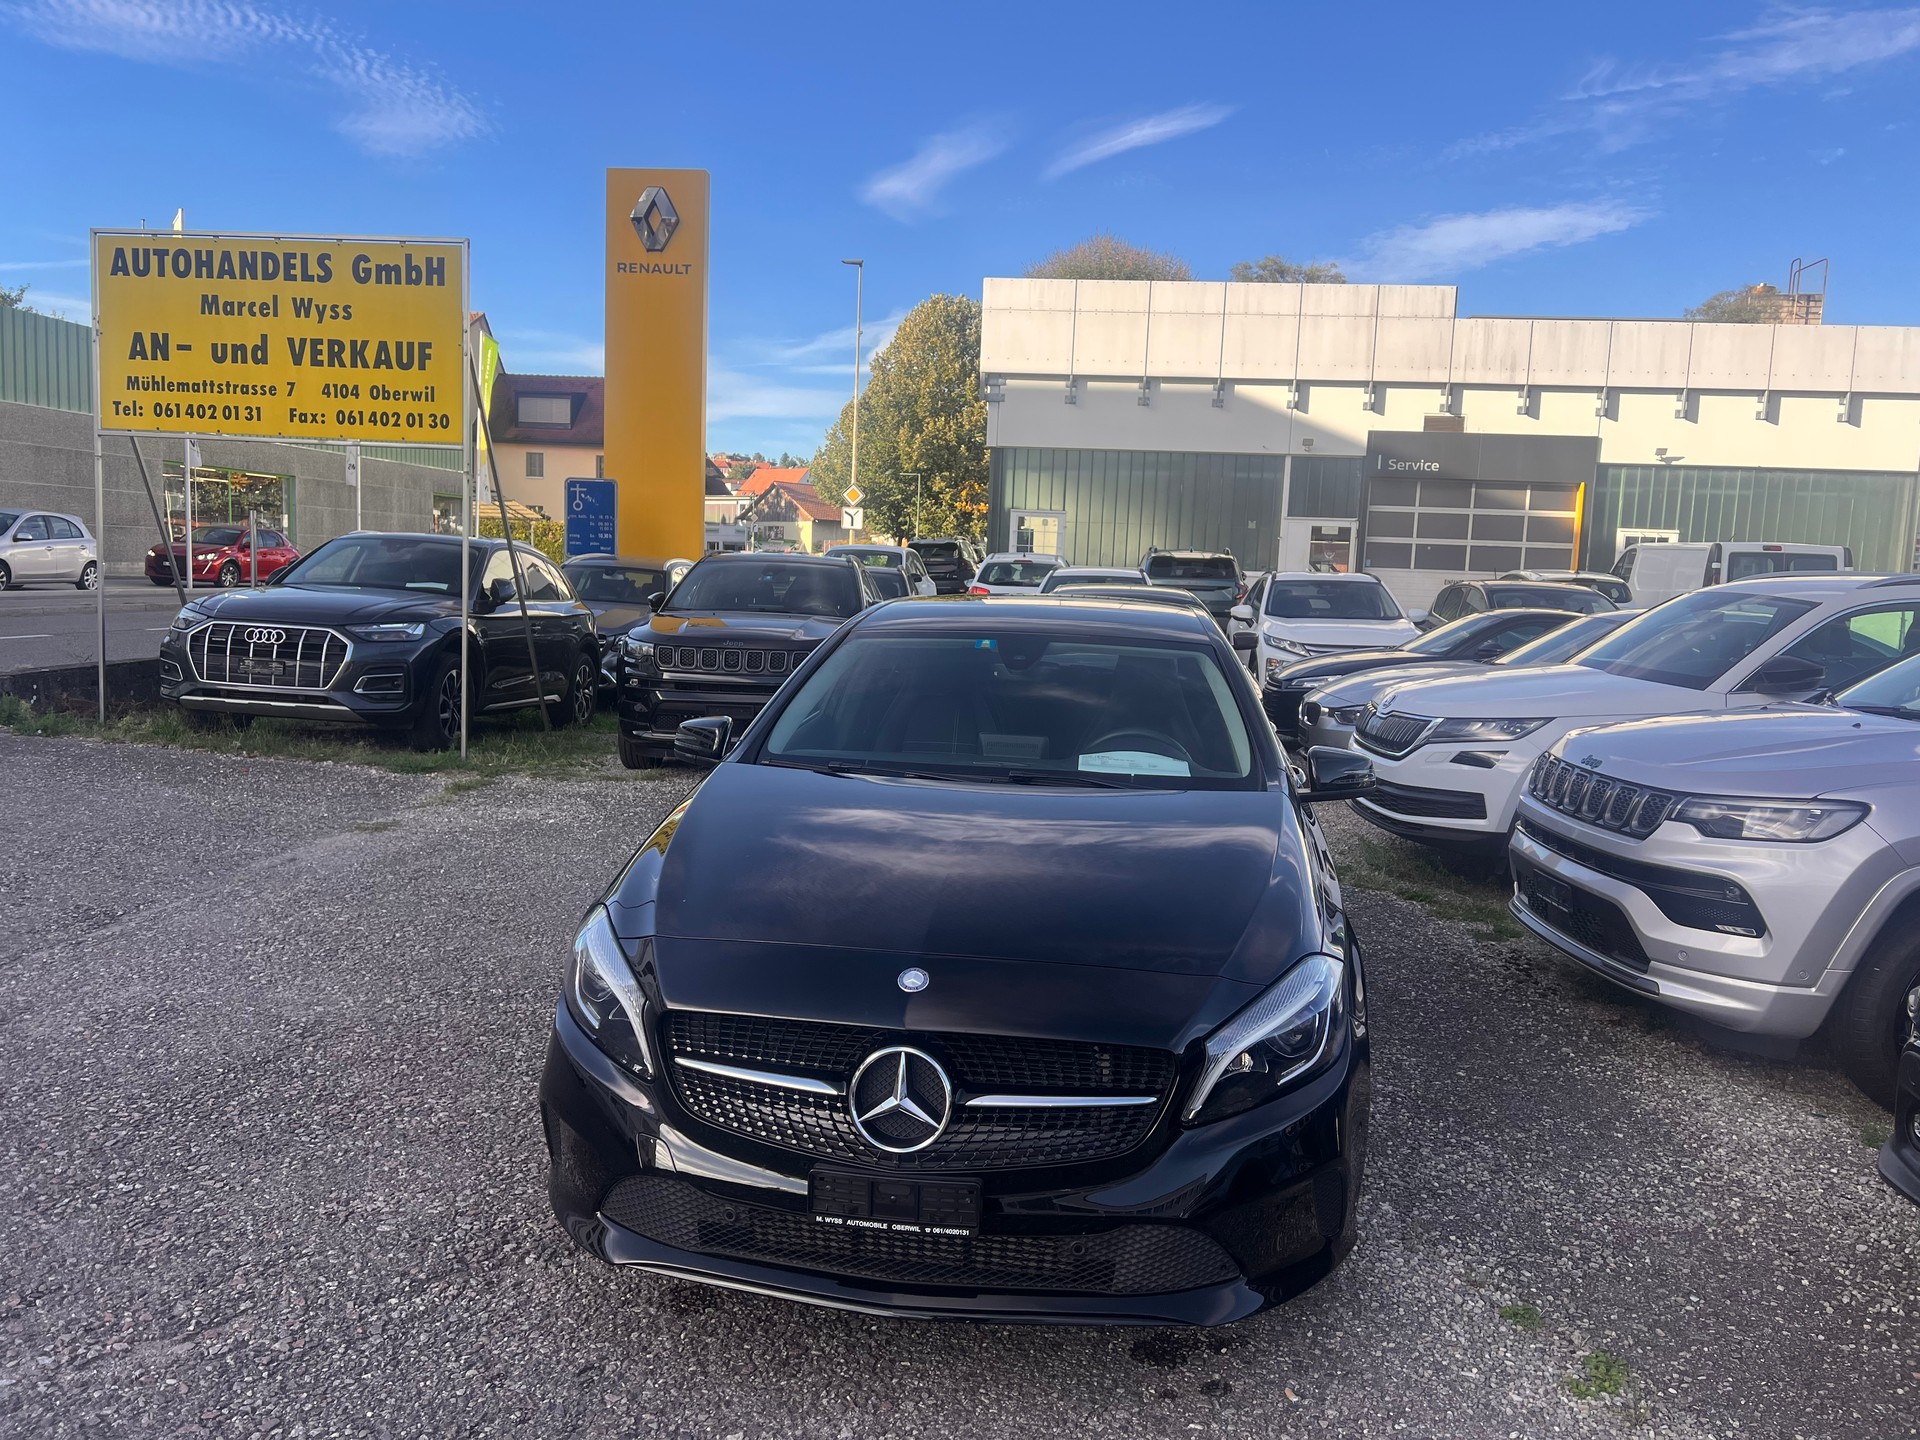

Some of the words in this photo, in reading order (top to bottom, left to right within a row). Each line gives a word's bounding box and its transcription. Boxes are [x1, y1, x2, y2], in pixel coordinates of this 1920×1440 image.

[110, 247, 333, 283] AUTOHANDELS
[351, 253, 446, 287] GmbH
[616, 262, 692, 275] RENAULT
[200, 293, 279, 318] Marcel
[291, 296, 353, 324] Wyss
[128, 331, 192, 362] AN-
[210, 333, 269, 366] und
[286, 336, 433, 371] VERKAUF
[126, 375, 278, 397] Mühlemattstrasse
[286, 381, 296, 397] 7
[321, 383, 360, 399] 4104
[369, 384, 435, 403] Oberwil
[112, 400, 144, 417] Tel:
[289, 407, 326, 425] Fax:
[1387, 458, 1440, 472] Service
[723, 640, 744, 648] Jeep
[816, 1215, 824, 1223] M.
[825, 1217, 843, 1225] WYSS
[846, 1219, 888, 1230] AUTOMOBILE
[892, 1223, 921, 1233] OBERWIL
[932, 1227, 970, 1236] 061/4020131
